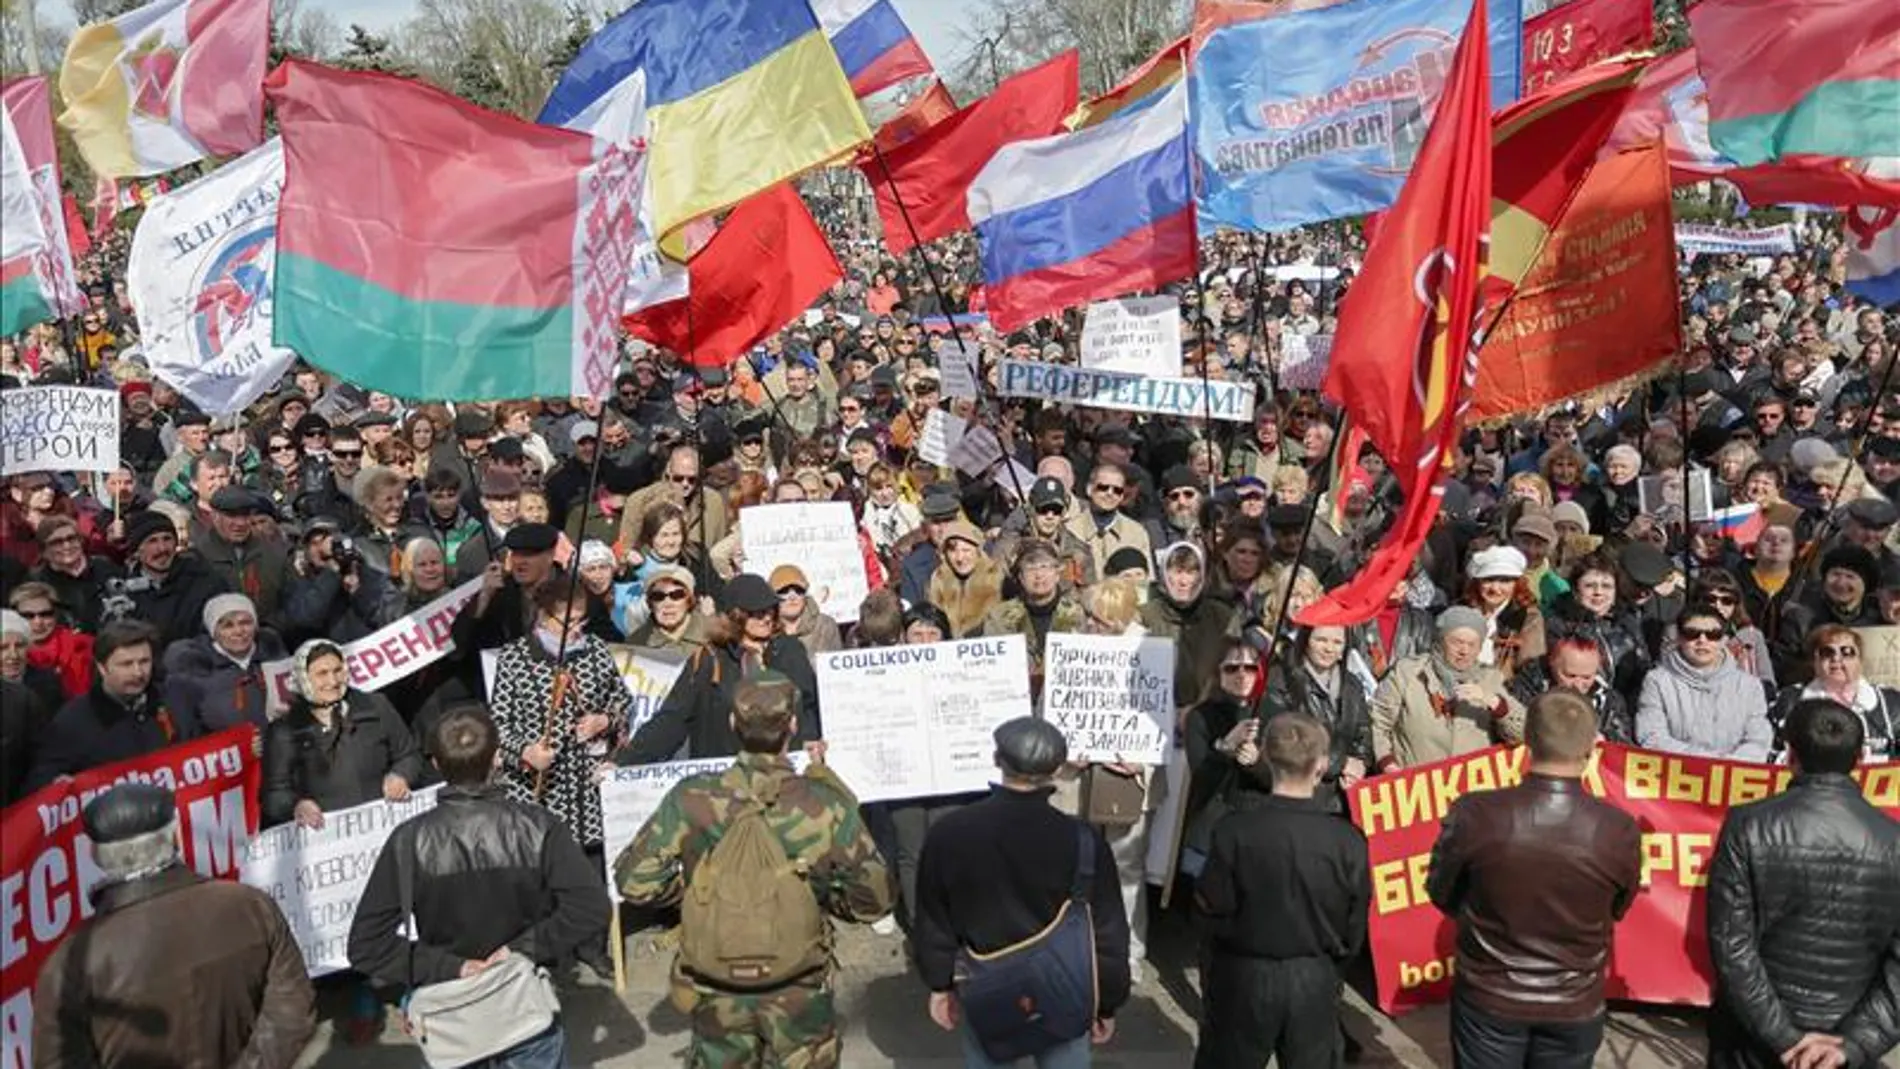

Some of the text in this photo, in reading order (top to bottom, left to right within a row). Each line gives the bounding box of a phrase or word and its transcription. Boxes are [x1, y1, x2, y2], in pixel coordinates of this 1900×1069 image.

[1, 388, 116, 419] ЕФЕРЕНДУМ
[1006, 362, 1244, 414] РЕФЕРЕНДУМ!
[274, 597, 472, 707] РЕРЕНД
[829, 647, 937, 671] COULIKOVO
[956, 640, 1007, 660] POLE
[1056, 711, 1139, 731] ХУНТА
[37, 744, 243, 836] borba.org
[1358, 744, 1607, 837] НИКАКХ
